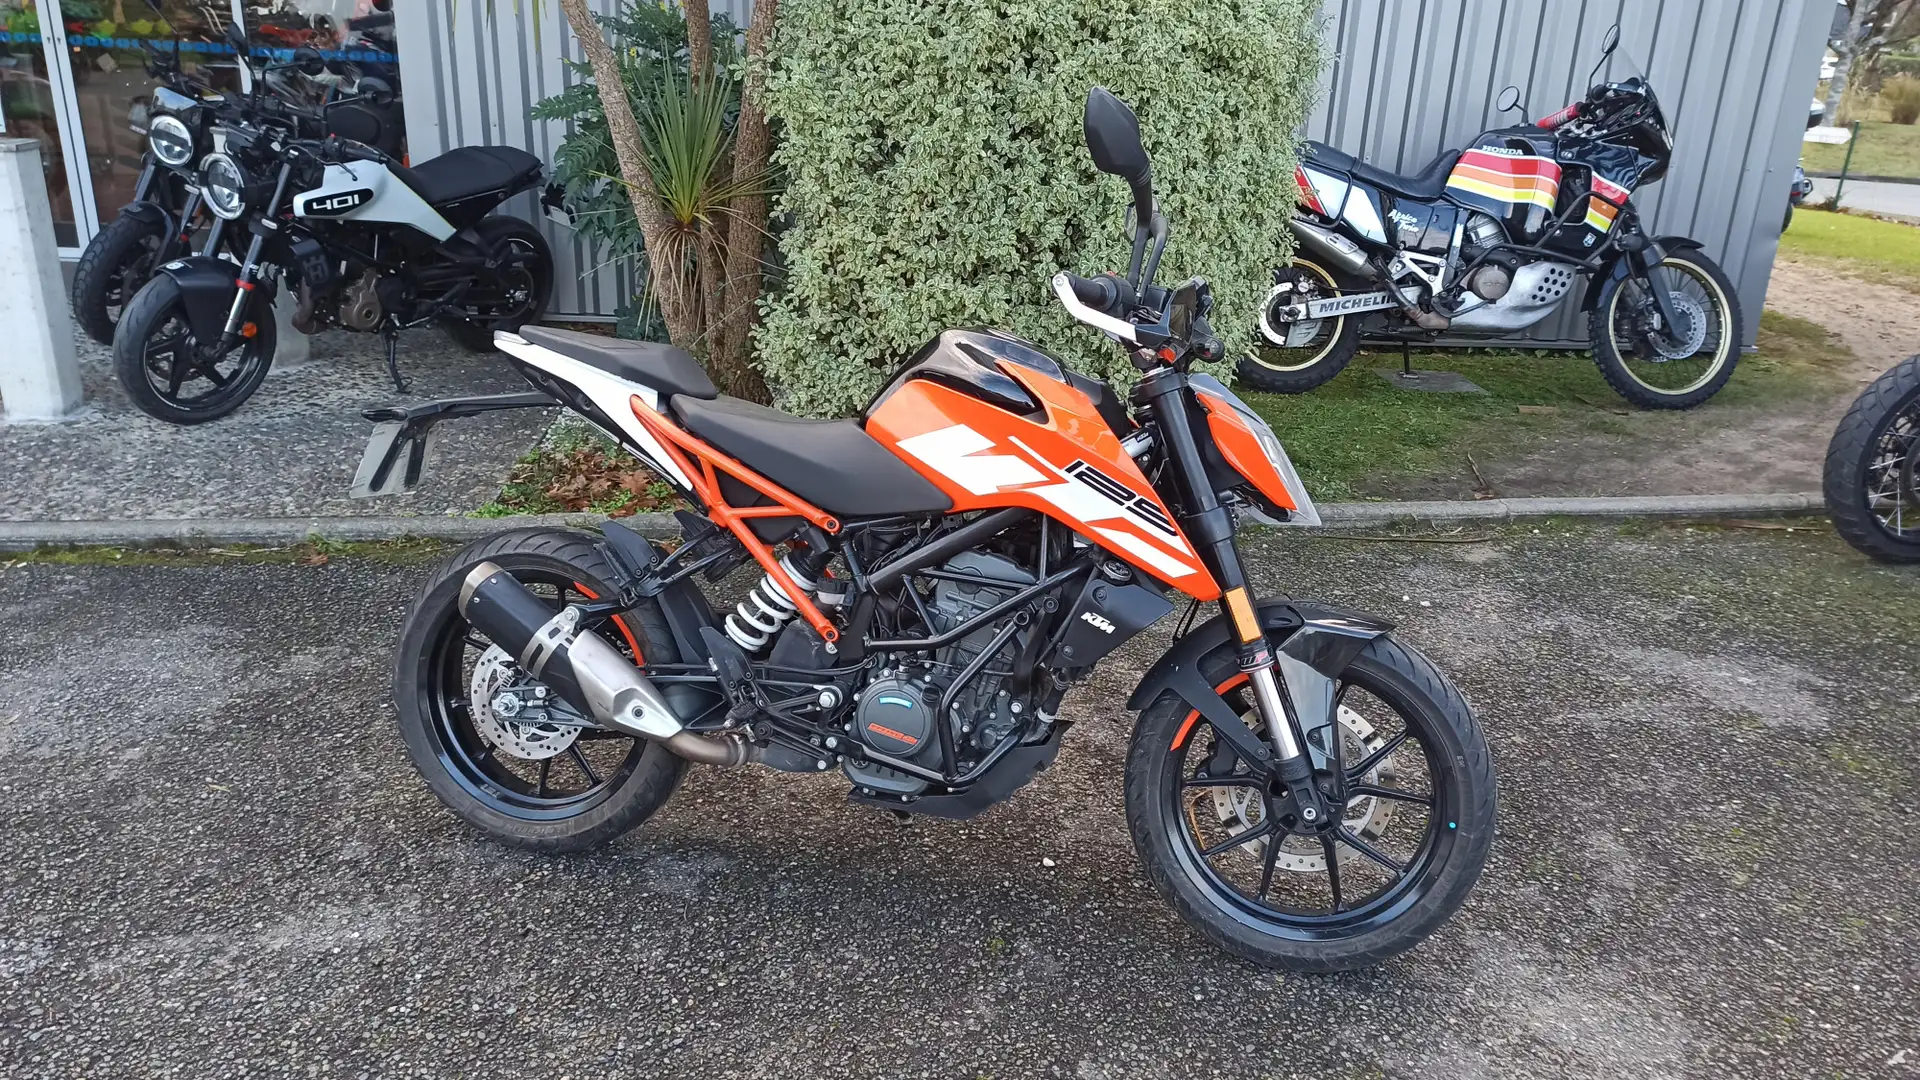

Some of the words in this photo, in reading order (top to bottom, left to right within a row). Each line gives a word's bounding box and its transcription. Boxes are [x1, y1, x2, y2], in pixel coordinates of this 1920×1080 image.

[1481, 144, 1524, 155] HONDA
[312, 194, 360, 210] 401
[1064, 460, 1180, 537] 125
[1080, 611, 1116, 634] KTM
